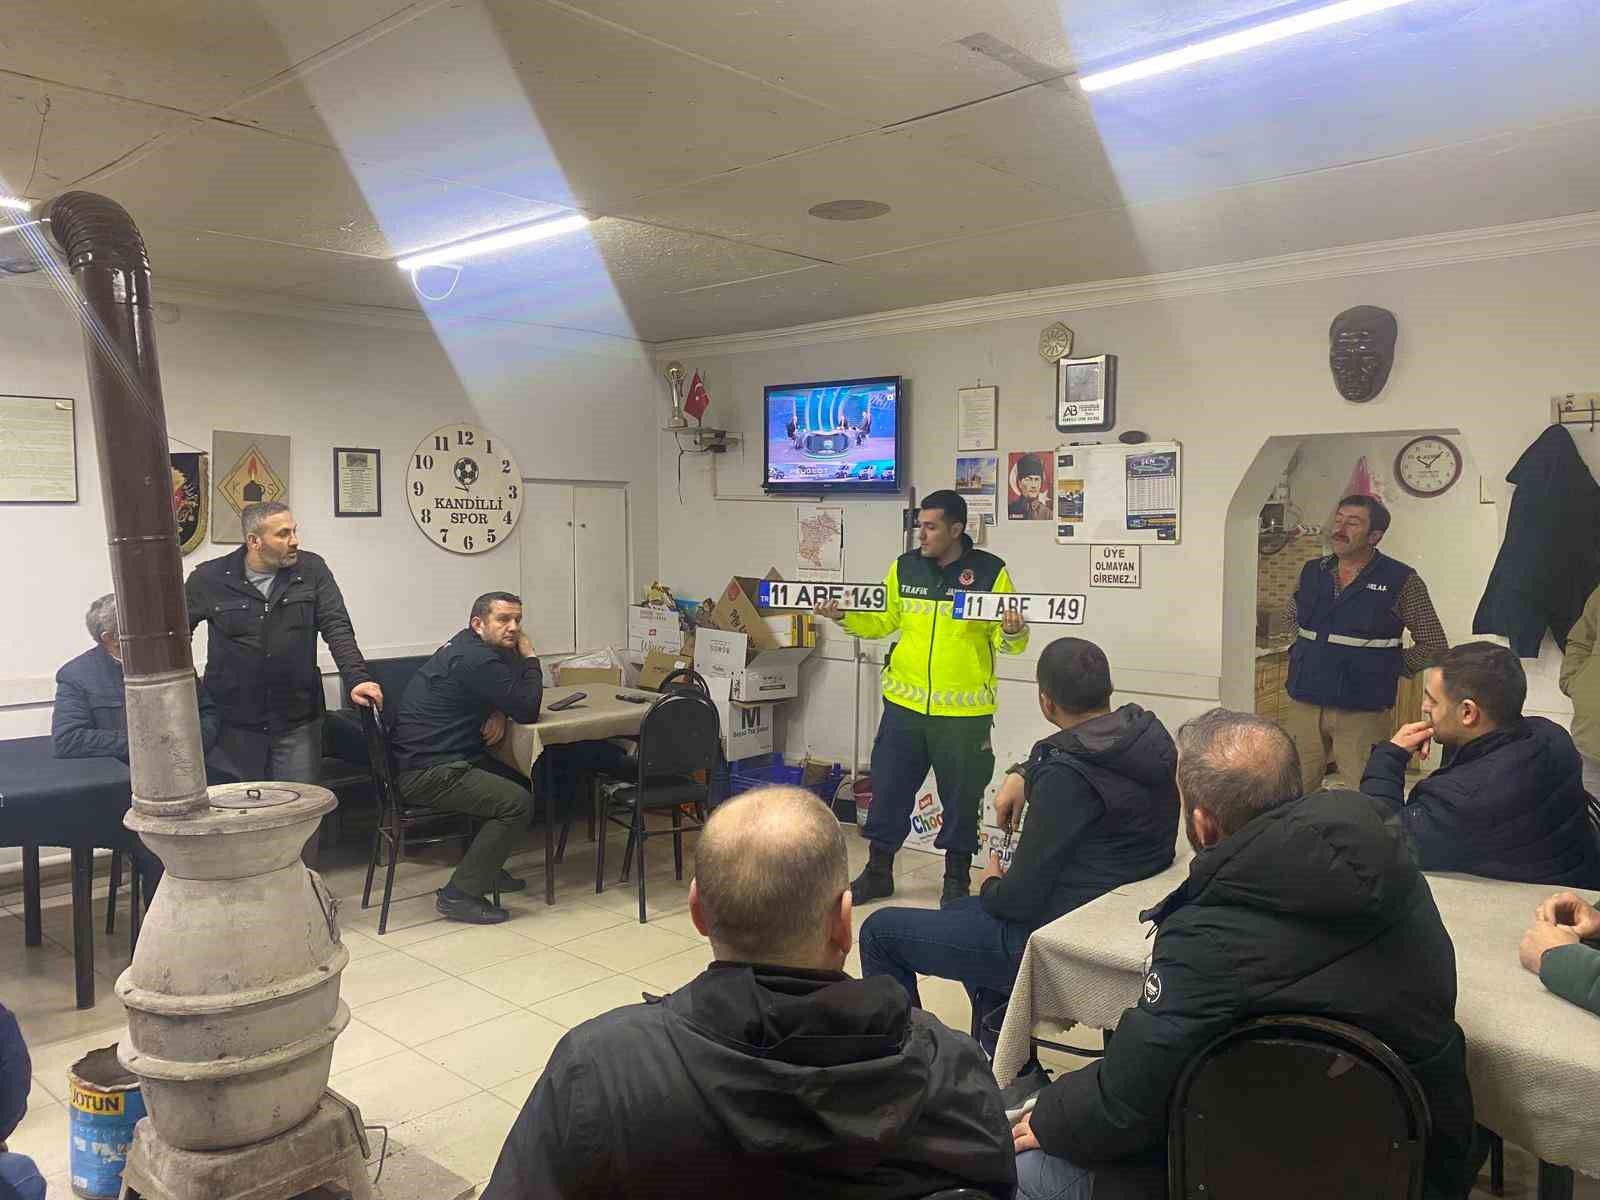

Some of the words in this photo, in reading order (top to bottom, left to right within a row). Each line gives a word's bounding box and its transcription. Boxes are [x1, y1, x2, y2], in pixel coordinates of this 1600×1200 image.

[435, 436, 449, 451] 11
[457, 431, 474, 445] 12
[486, 440, 492, 454] 1
[415, 455, 434, 470] 10
[502, 460, 511, 473] 2
[413, 481, 424, 496] 9
[509, 486, 517, 499] 3
[434, 496, 504, 511] KANDİLLİ
[421, 509, 431, 524] 8
[450, 513, 489, 525] SPOR
[503, 511, 512, 525] 4
[440, 529, 448, 543] 7
[464, 536, 473, 550] 6
[487, 529, 496, 543] 5
[1103, 547, 1125, 558] ÜYE
[1095, 561, 1135, 571] OLMAYAN
[771, 584, 788, 606] 11
[851, 587, 885, 608] 149
[967, 596, 984, 617] 11
[1048, 598, 1080, 620] 149
[72, 1089, 120, 1112] JOTUN
